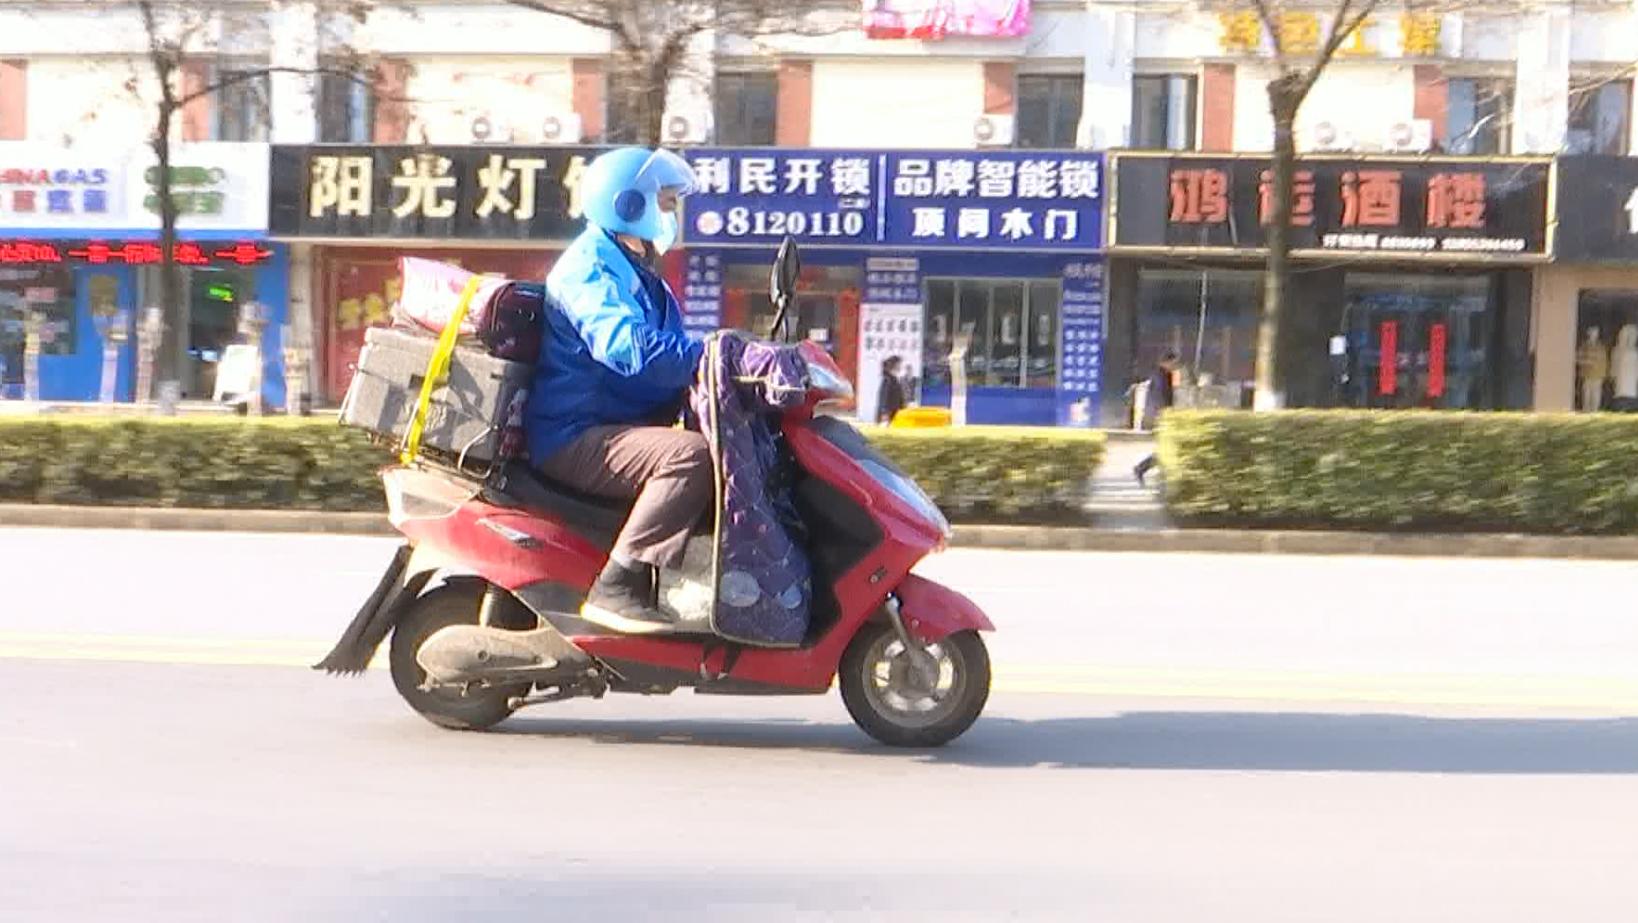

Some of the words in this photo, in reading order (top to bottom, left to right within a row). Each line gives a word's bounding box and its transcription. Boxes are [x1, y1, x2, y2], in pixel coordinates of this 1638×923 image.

[693, 157, 871, 195] 利民开锁
[894, 159, 1099, 198] 品牌智能锁
[726, 206, 863, 236] 8120110
